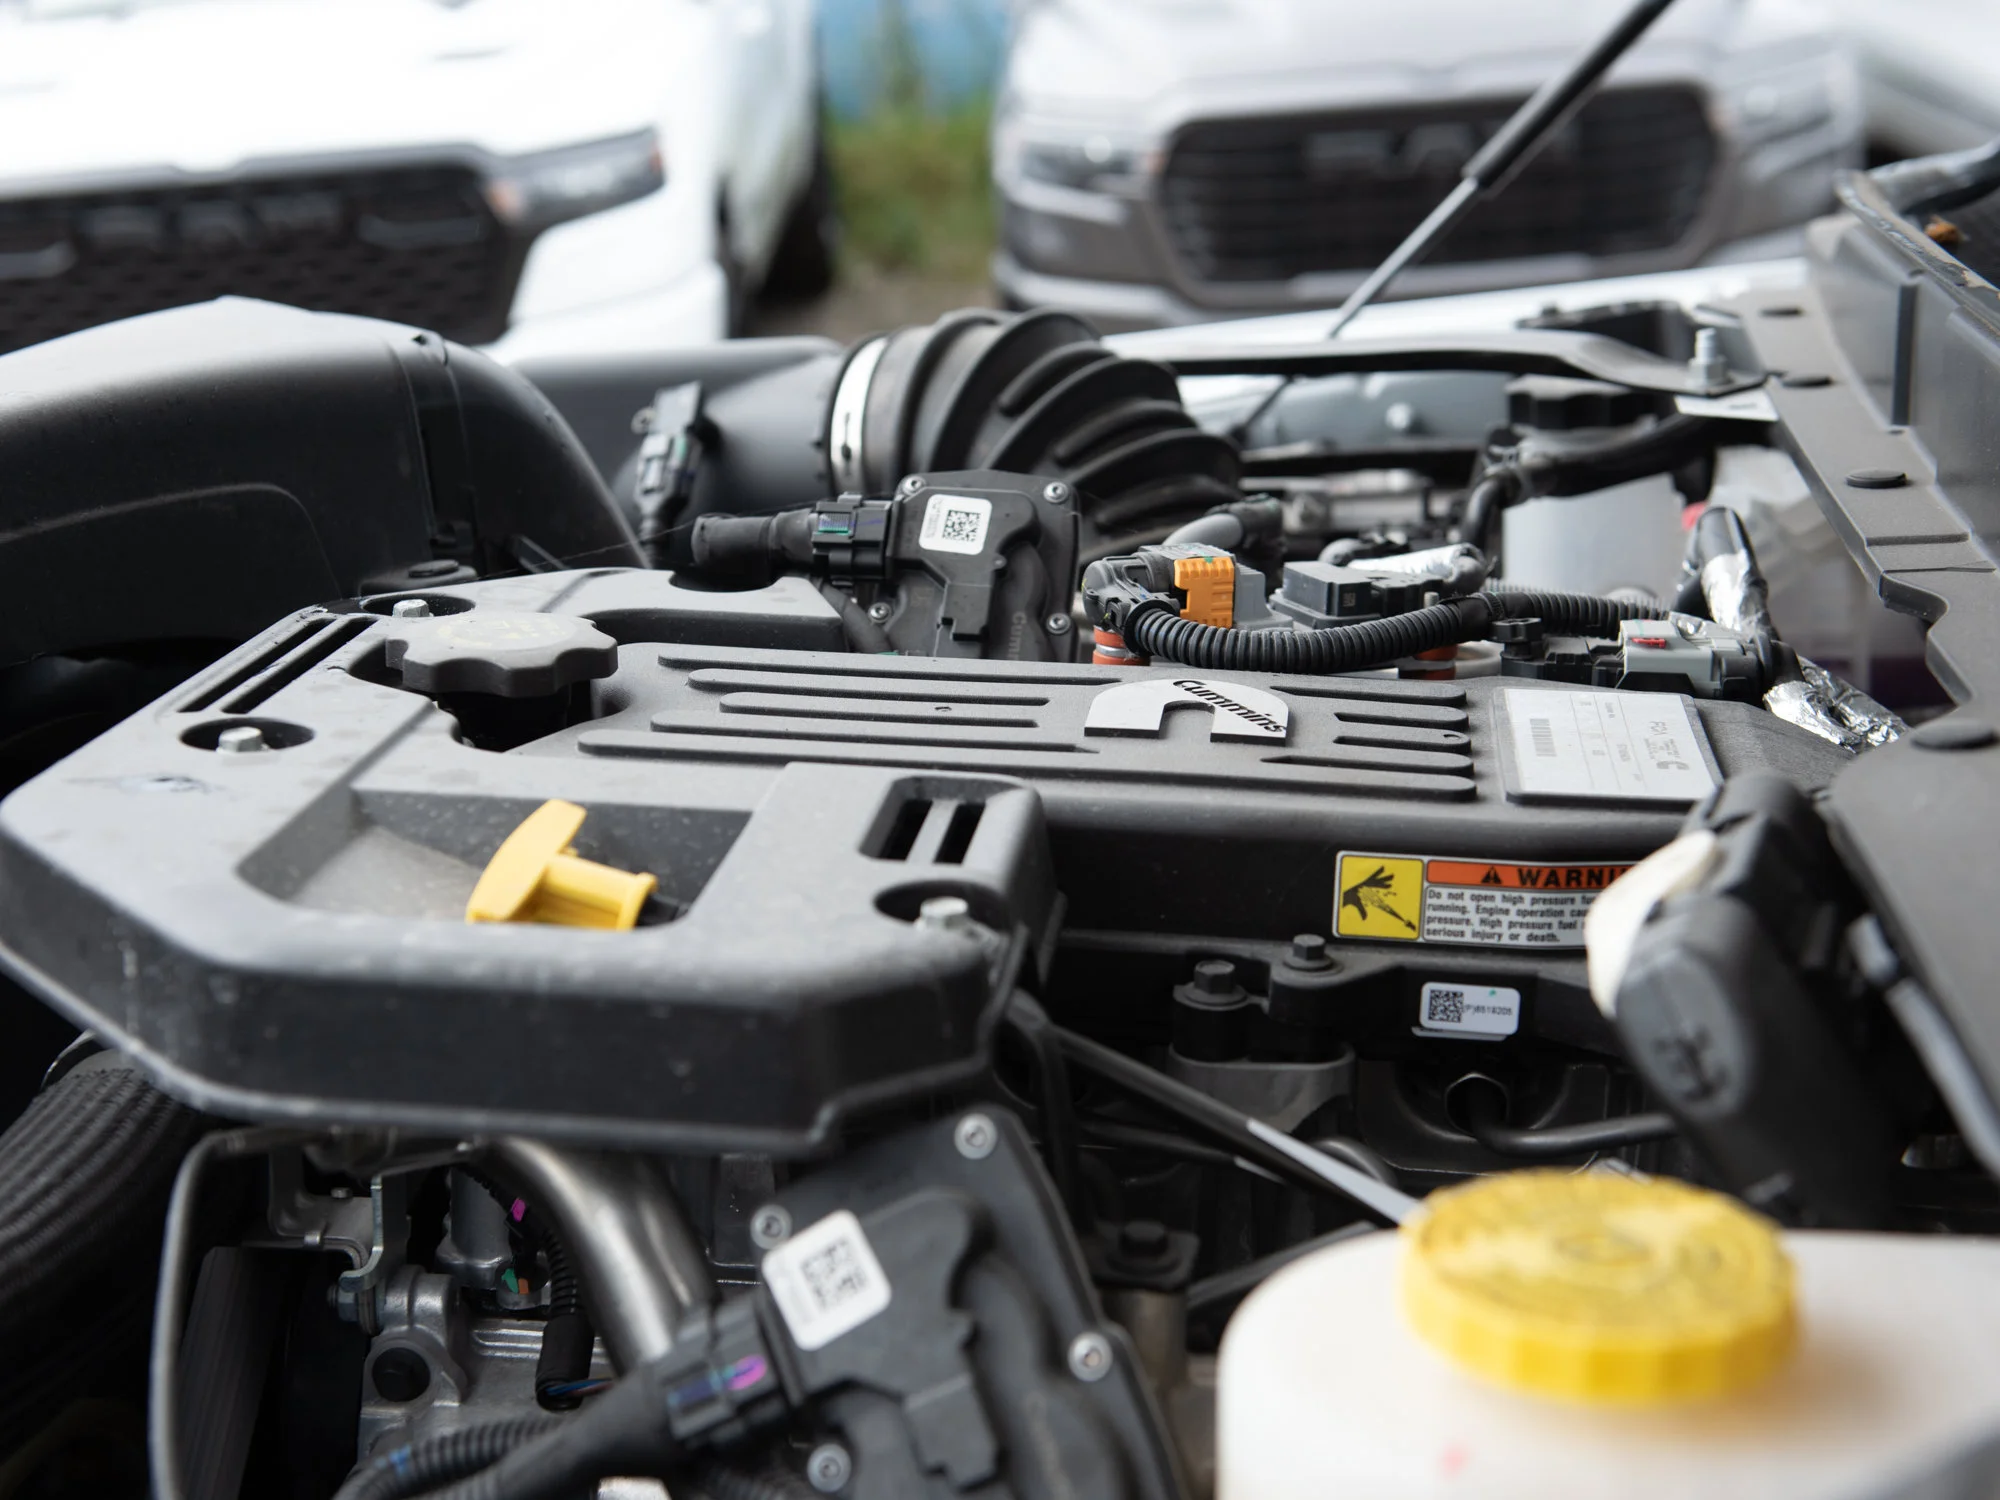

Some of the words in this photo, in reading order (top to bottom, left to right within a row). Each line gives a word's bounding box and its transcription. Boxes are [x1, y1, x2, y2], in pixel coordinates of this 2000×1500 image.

[1173, 680, 1287, 733] Cummins
[1517, 867, 1629, 887] WARNI
[1428, 889, 1441, 899] Do
[1448, 890, 1464, 900] not
[1470, 893, 1496, 903] open
[1502, 893, 1524, 906] high
[1530, 895, 1576, 906] pressure
[1581, 894, 1597, 905] fu
[1427, 902, 1470, 914] running.
[1476, 904, 1510, 917] Engine
[1516, 906, 1565, 918] operation
[1426, 915, 1474, 926] pressure.
[1479, 917, 1502, 930] High
[1508, 919, 1553, 930] pressure
[1558, 919, 1577, 930] fuel
[1426, 927, 1466, 938] serious
[1471, 928, 1502, 941] injury
[1509, 931, 1520, 941] or
[1526, 931, 1560, 942] death.
